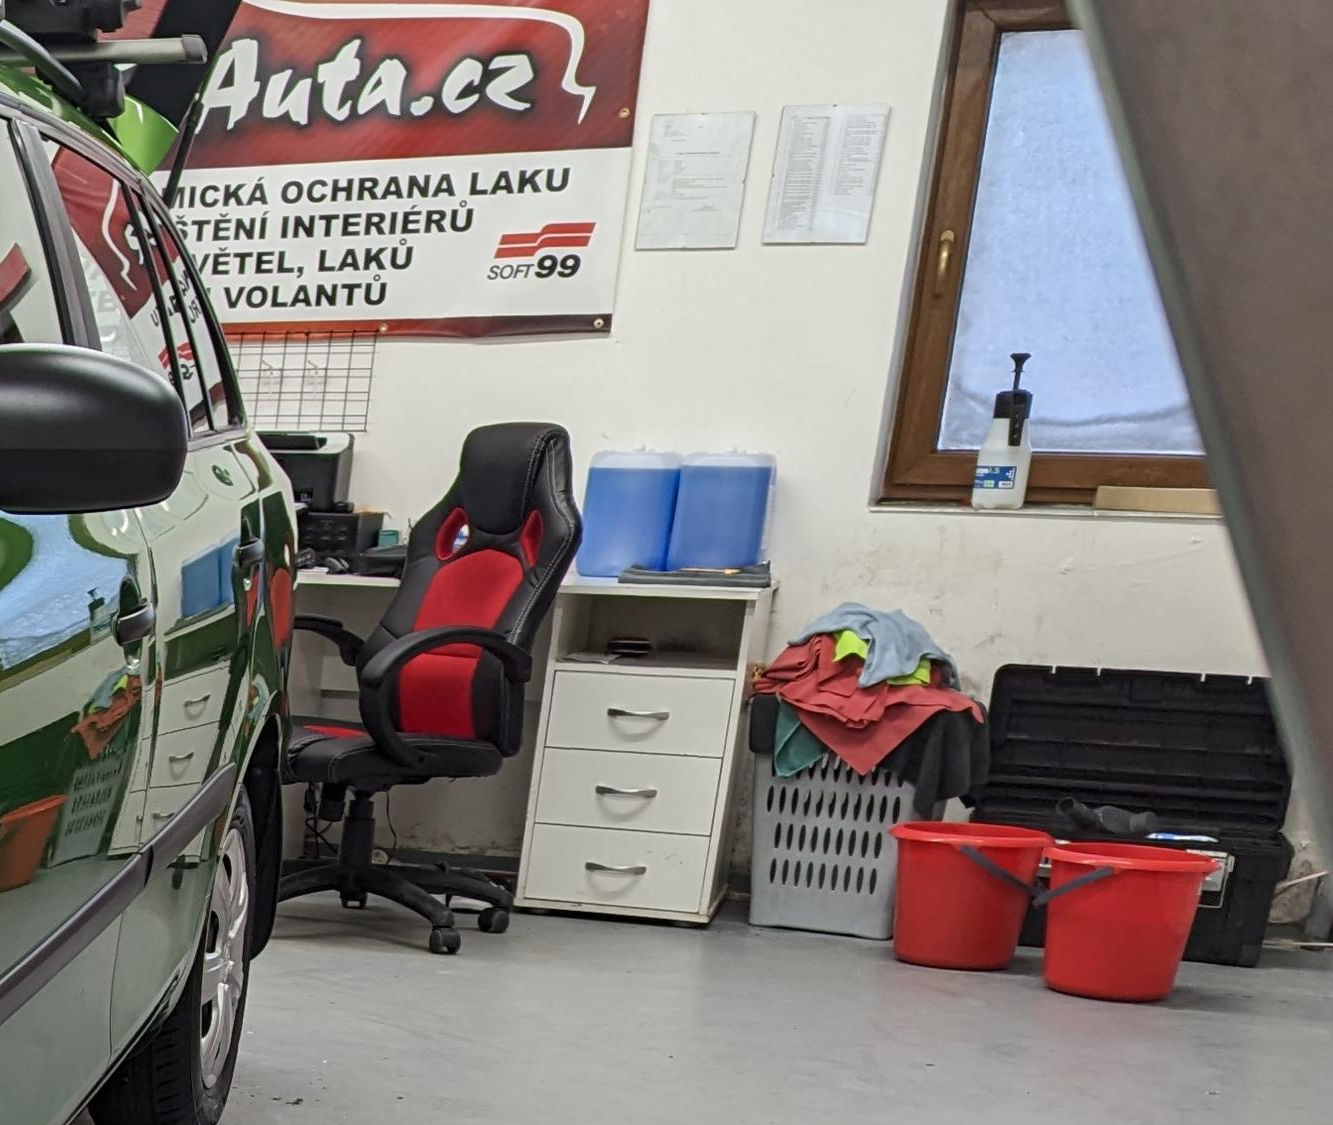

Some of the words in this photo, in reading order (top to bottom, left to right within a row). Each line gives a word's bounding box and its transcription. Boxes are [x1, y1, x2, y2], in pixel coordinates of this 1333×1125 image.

[195, 38, 535, 135] Auta.cz
[162, 177, 270, 210] MICKÁ
[280, 173, 456, 205] OCHRANA
[468, 167, 571, 196] LAKU
[175, 211, 271, 243] ŠTĚNÍ
[280, 200, 475, 239] INTERIÉRŮ
[192, 247, 305, 279] VĚTEL,
[317, 238, 414, 273] LAKŮ
[224, 274, 388, 309] VOLANTŮ
